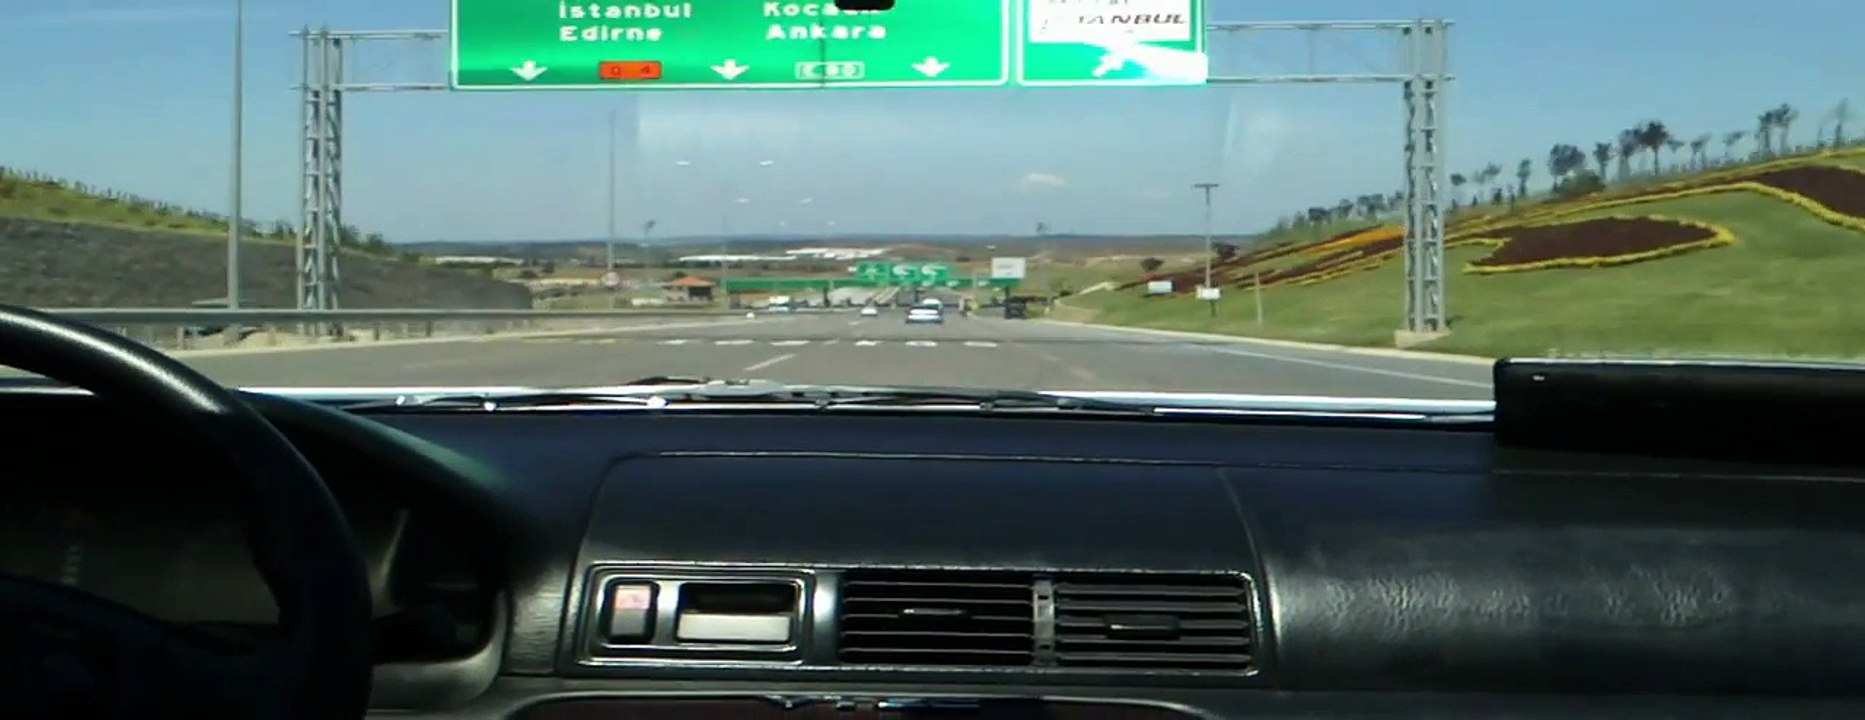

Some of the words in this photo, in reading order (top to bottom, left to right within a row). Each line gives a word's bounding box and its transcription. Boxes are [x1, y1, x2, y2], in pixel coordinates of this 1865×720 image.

[763, 2, 880, 17] Koca
[559, 24, 663, 42] Edirne
[766, 23, 887, 41] Ankara
